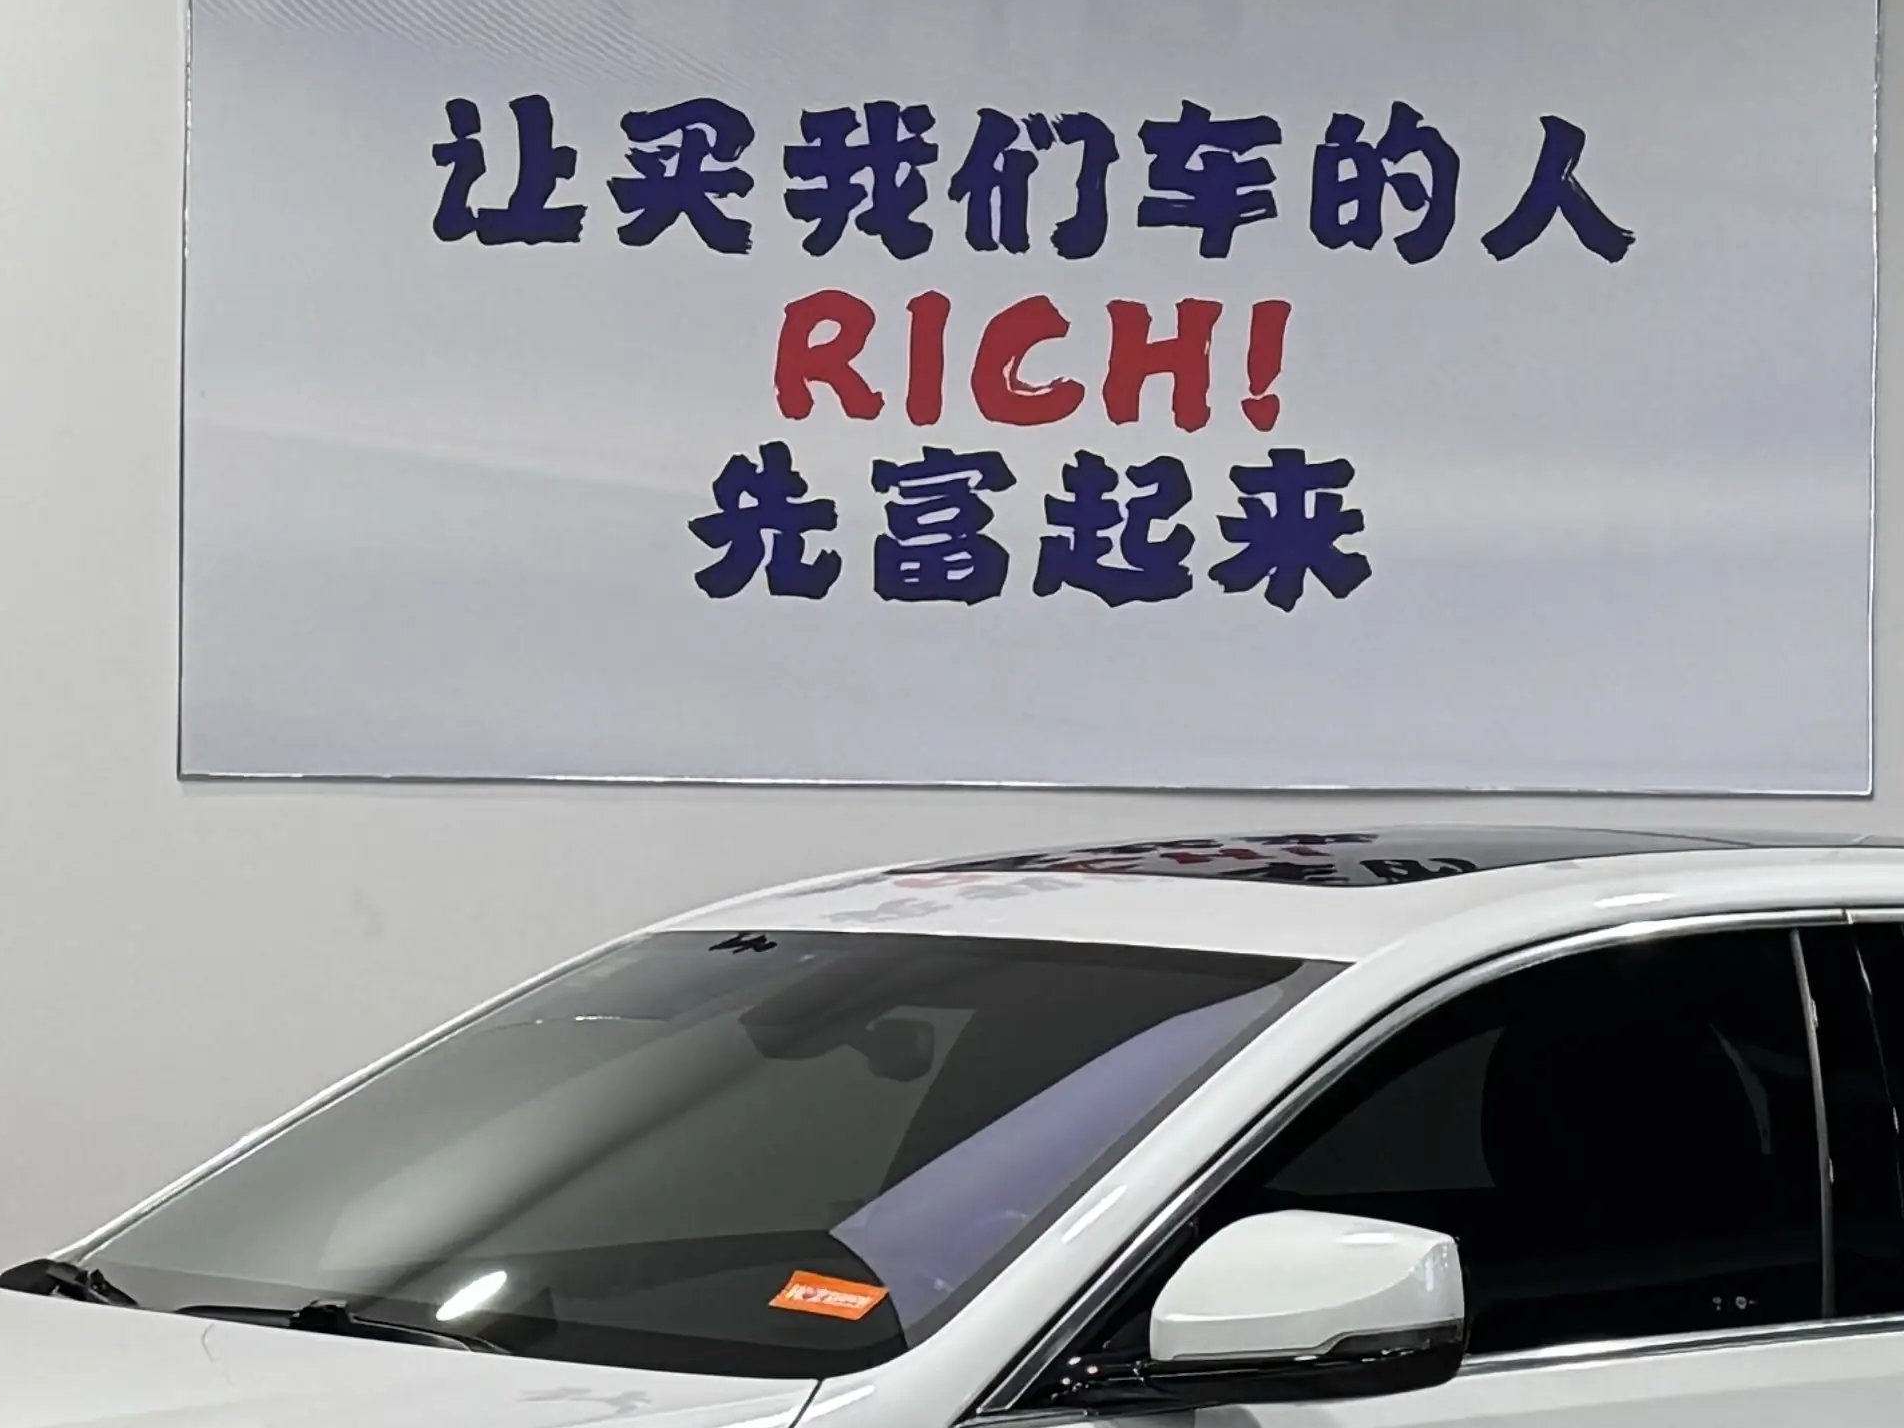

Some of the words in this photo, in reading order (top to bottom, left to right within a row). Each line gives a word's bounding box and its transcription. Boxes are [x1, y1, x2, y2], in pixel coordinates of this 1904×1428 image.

[432, 95, 1635, 264] 让买我们车的人
[776, 291, 1292, 432] RICH!
[689, 441, 1372, 612] 先富起来
